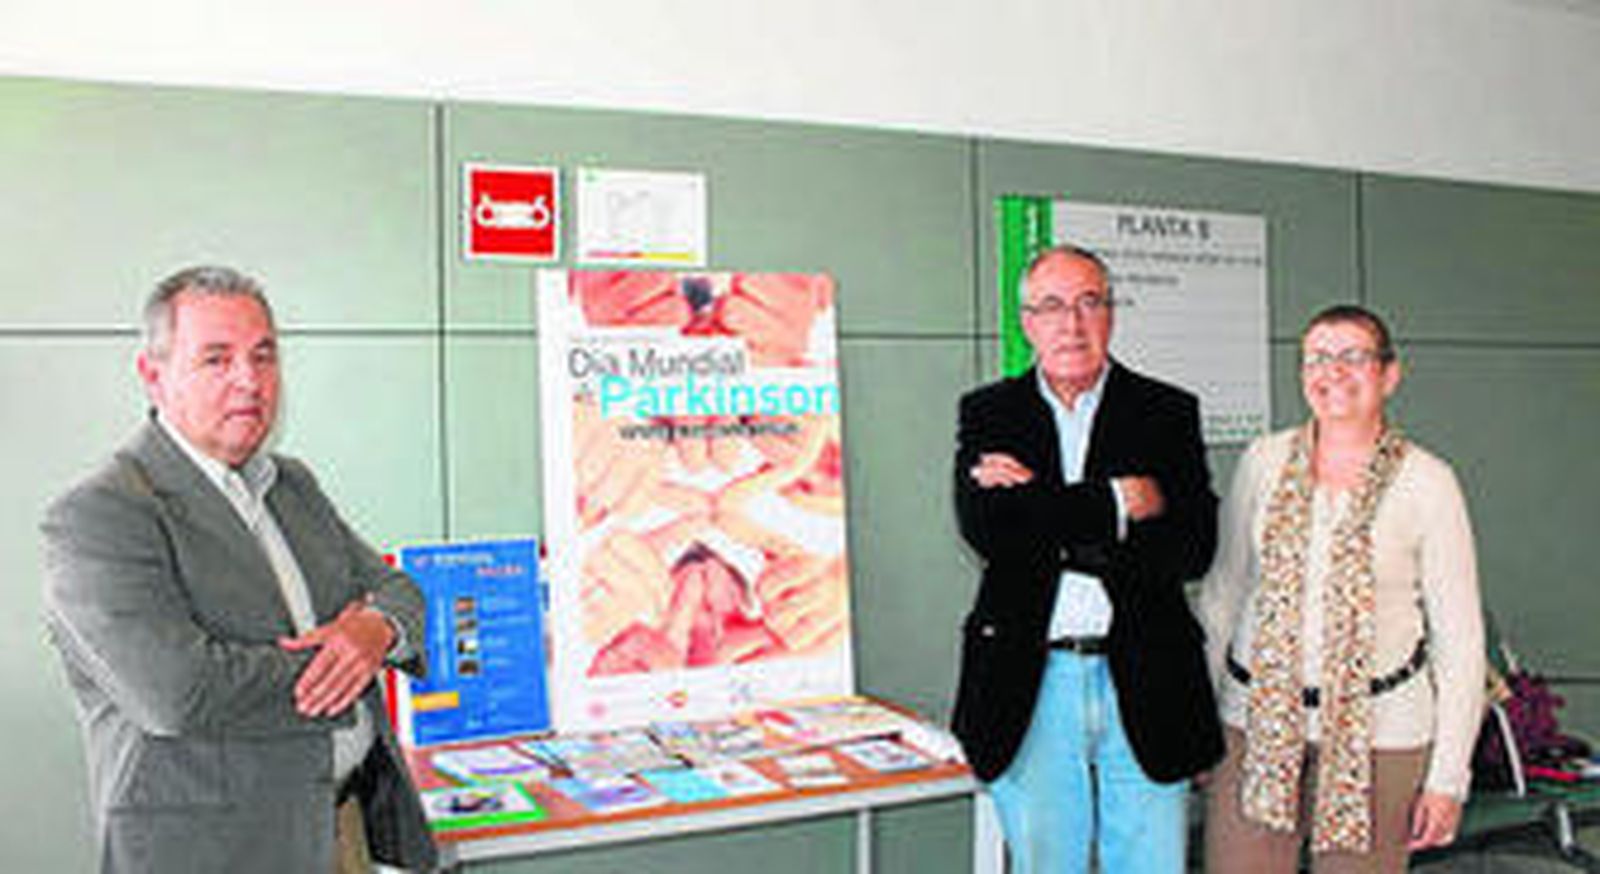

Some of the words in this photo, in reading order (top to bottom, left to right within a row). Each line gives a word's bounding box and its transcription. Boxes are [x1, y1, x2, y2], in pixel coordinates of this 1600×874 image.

[1116, 213, 1194, 237] PLANTA
[629, 347, 746, 378] Mundial
[599, 373, 840, 418] Parkinson
